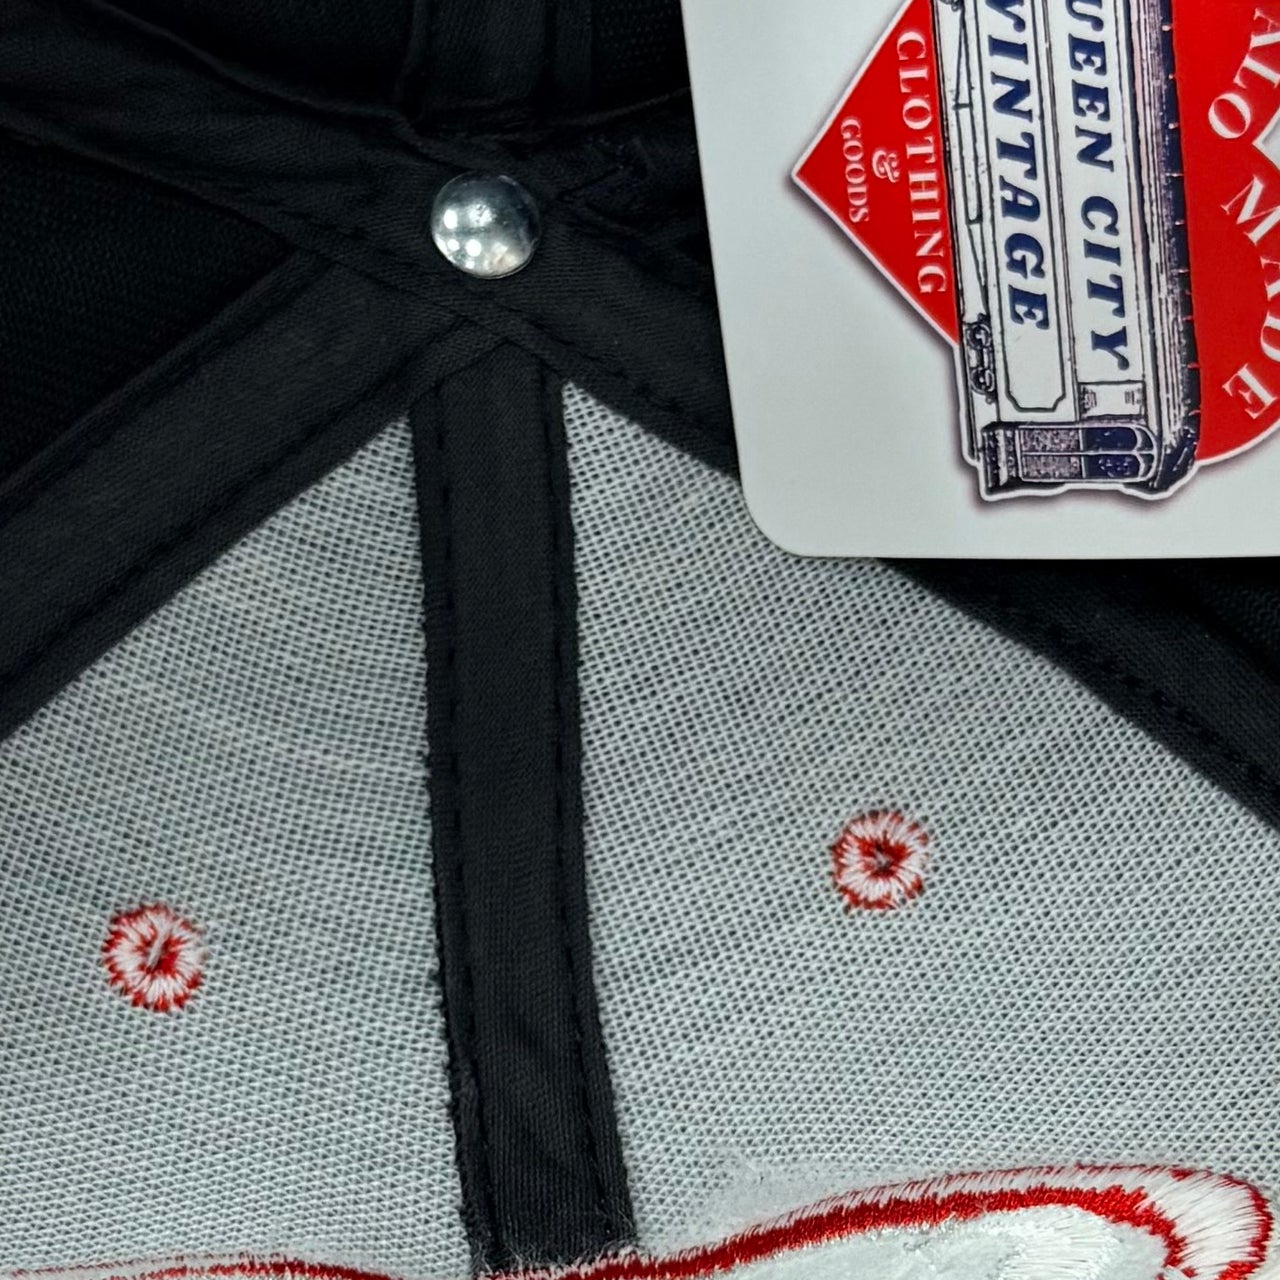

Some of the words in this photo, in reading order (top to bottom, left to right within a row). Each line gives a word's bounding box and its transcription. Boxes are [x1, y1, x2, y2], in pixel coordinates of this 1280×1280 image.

[840, 116, 869, 224] GOODS
[871, 148, 900, 183] &
[896, 30, 947, 294] CLOTHING
[1080, 195, 1130, 371] CITY
